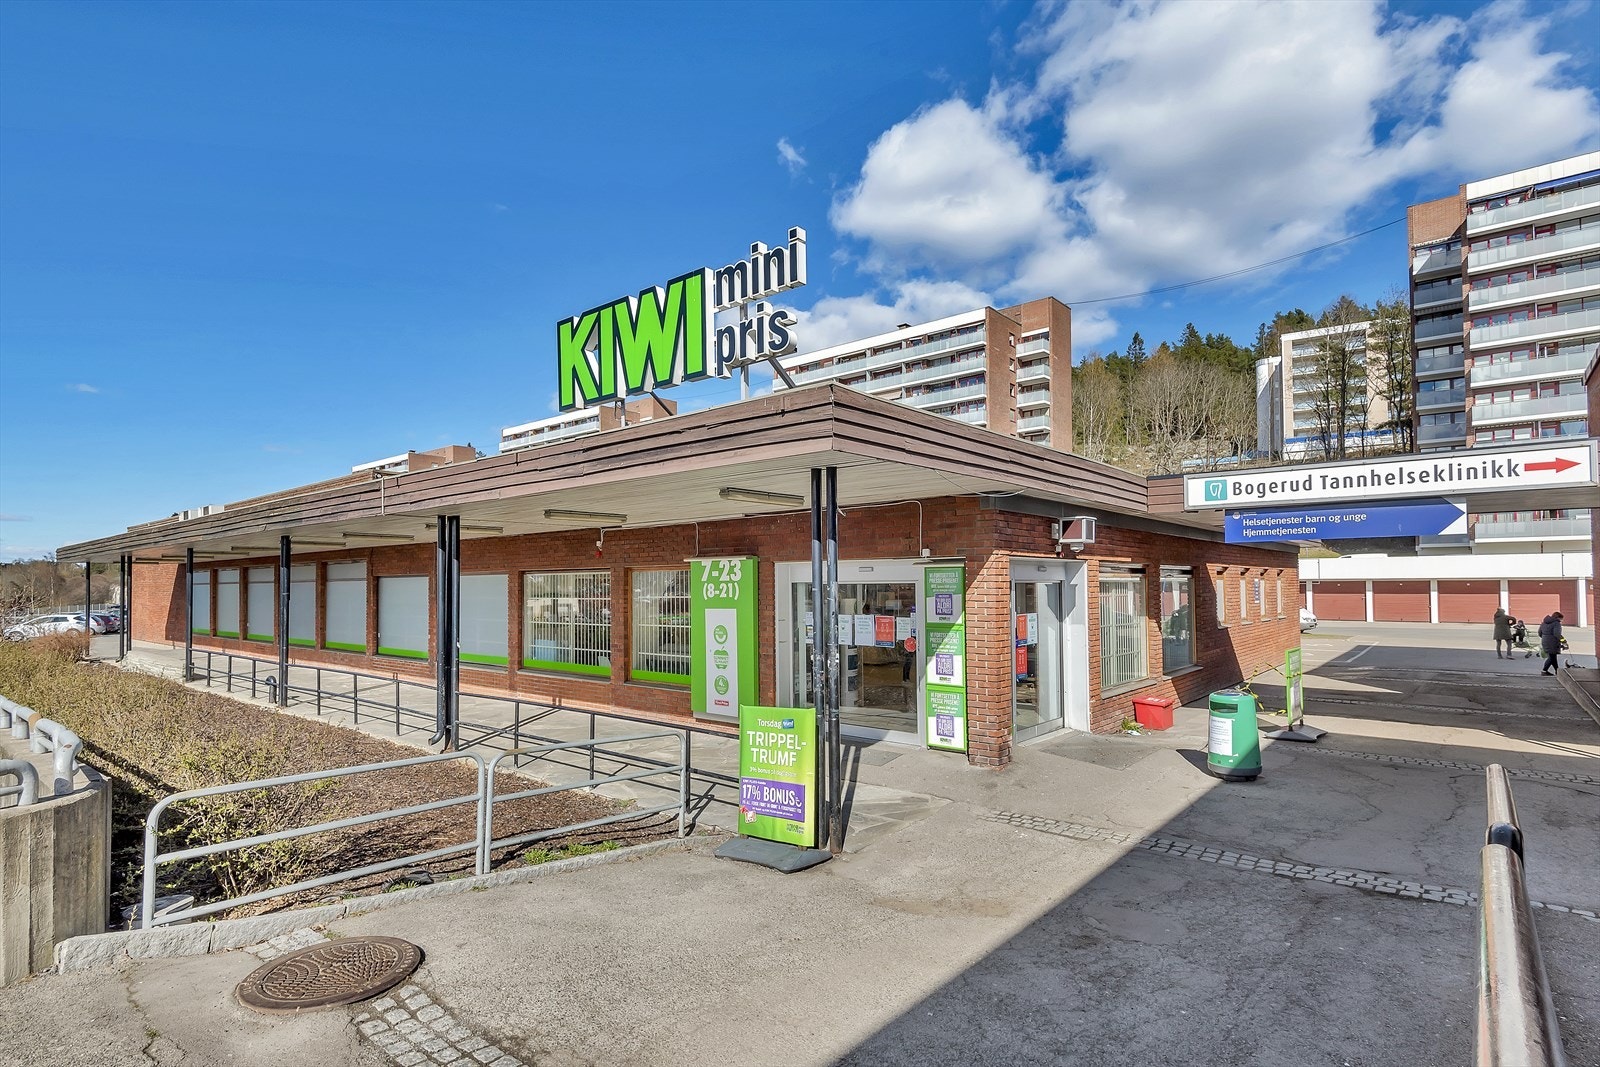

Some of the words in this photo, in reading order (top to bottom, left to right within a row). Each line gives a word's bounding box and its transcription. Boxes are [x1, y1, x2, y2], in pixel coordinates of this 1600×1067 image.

[715, 226, 806, 309] mini
[557, 267, 711, 412] KIWI
[716, 302, 797, 378] pris
[1233, 474, 1312, 498] Bogerud
[1319, 458, 1520, 490] Tannhelseklinikk
[1243, 516, 1303, 527] Helsetjenester
[1305, 514, 1326, 523] barn
[1329, 515, 1340, 523] og
[1344, 513, 1367, 522] unge
[1243, 527, 1316, 538] Hjemmetjenesten
[701, 559, 742, 581] 7-23
[703, 582, 739, 600] (8-21)
[757, 719, 782, 729] Torsdag
[747, 731, 807, 750] TRIPPEL-
[750, 748, 797, 767] TRUMF
[742, 784, 761, 800] 17%
[763, 786, 796, 806] BONUS
